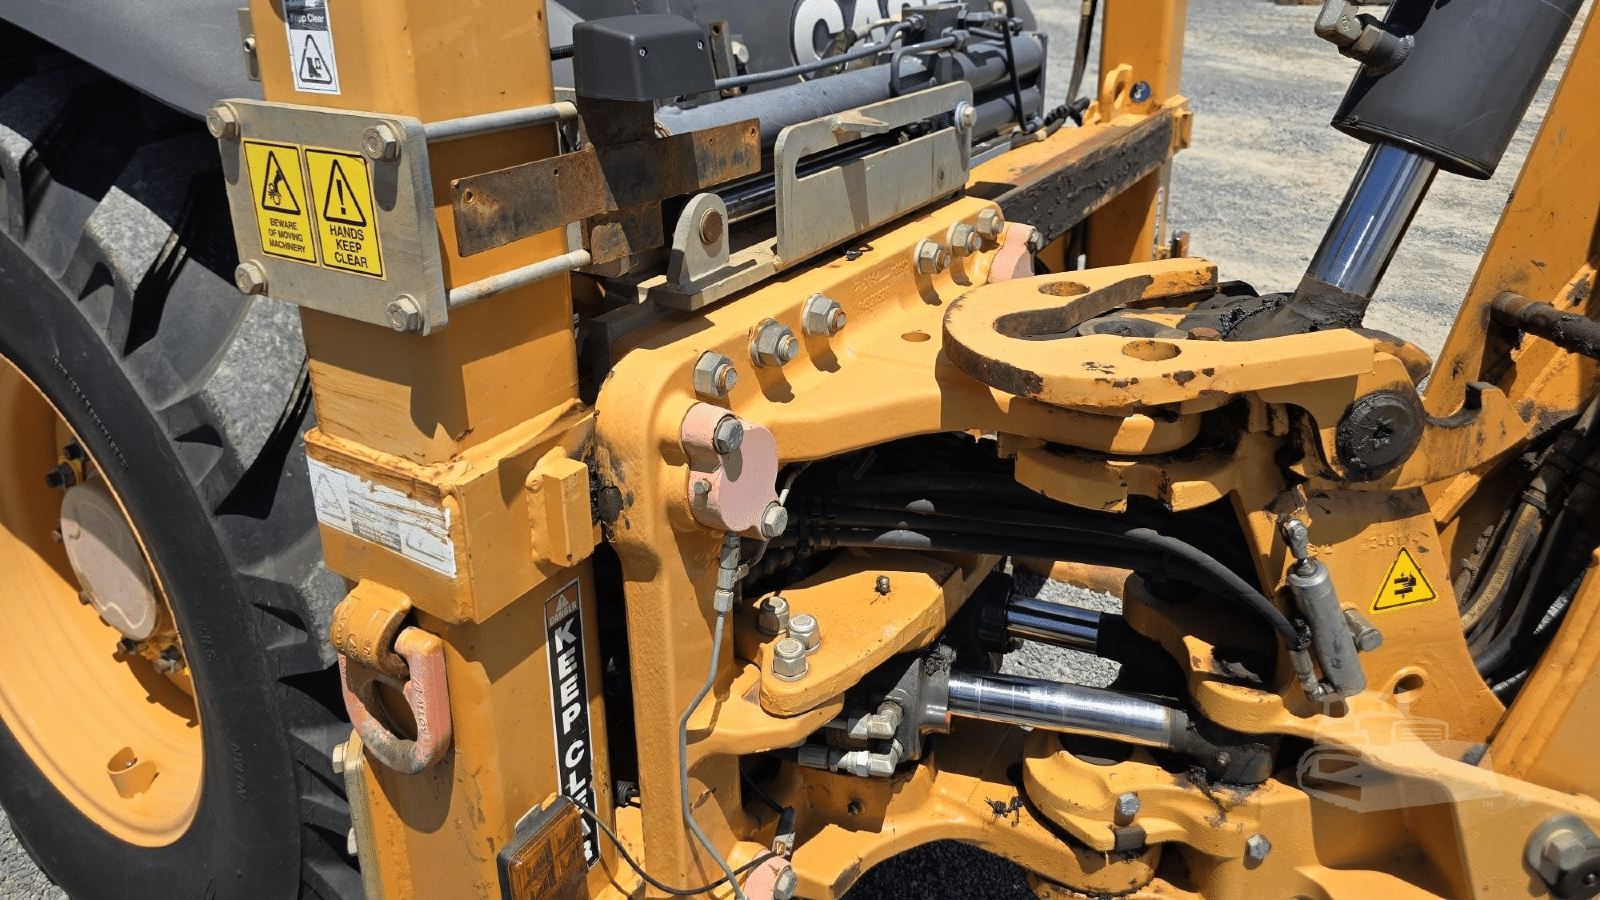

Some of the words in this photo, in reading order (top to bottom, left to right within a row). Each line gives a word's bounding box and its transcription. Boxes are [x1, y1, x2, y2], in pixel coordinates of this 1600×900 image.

[307, 13, 324, 23] Clear
[269, 217, 298, 231] BEWARE
[268, 228, 277, 237] OF
[277, 229, 304, 243] MOVING
[329, 224, 365, 242] HANDS
[269, 238, 306, 254] MACHINERY
[335, 238, 362, 254] KEEP
[334, 251, 369, 269] CLEAR
[548, 600, 577, 628] DANGER
[554, 616, 582, 735] KEEP
